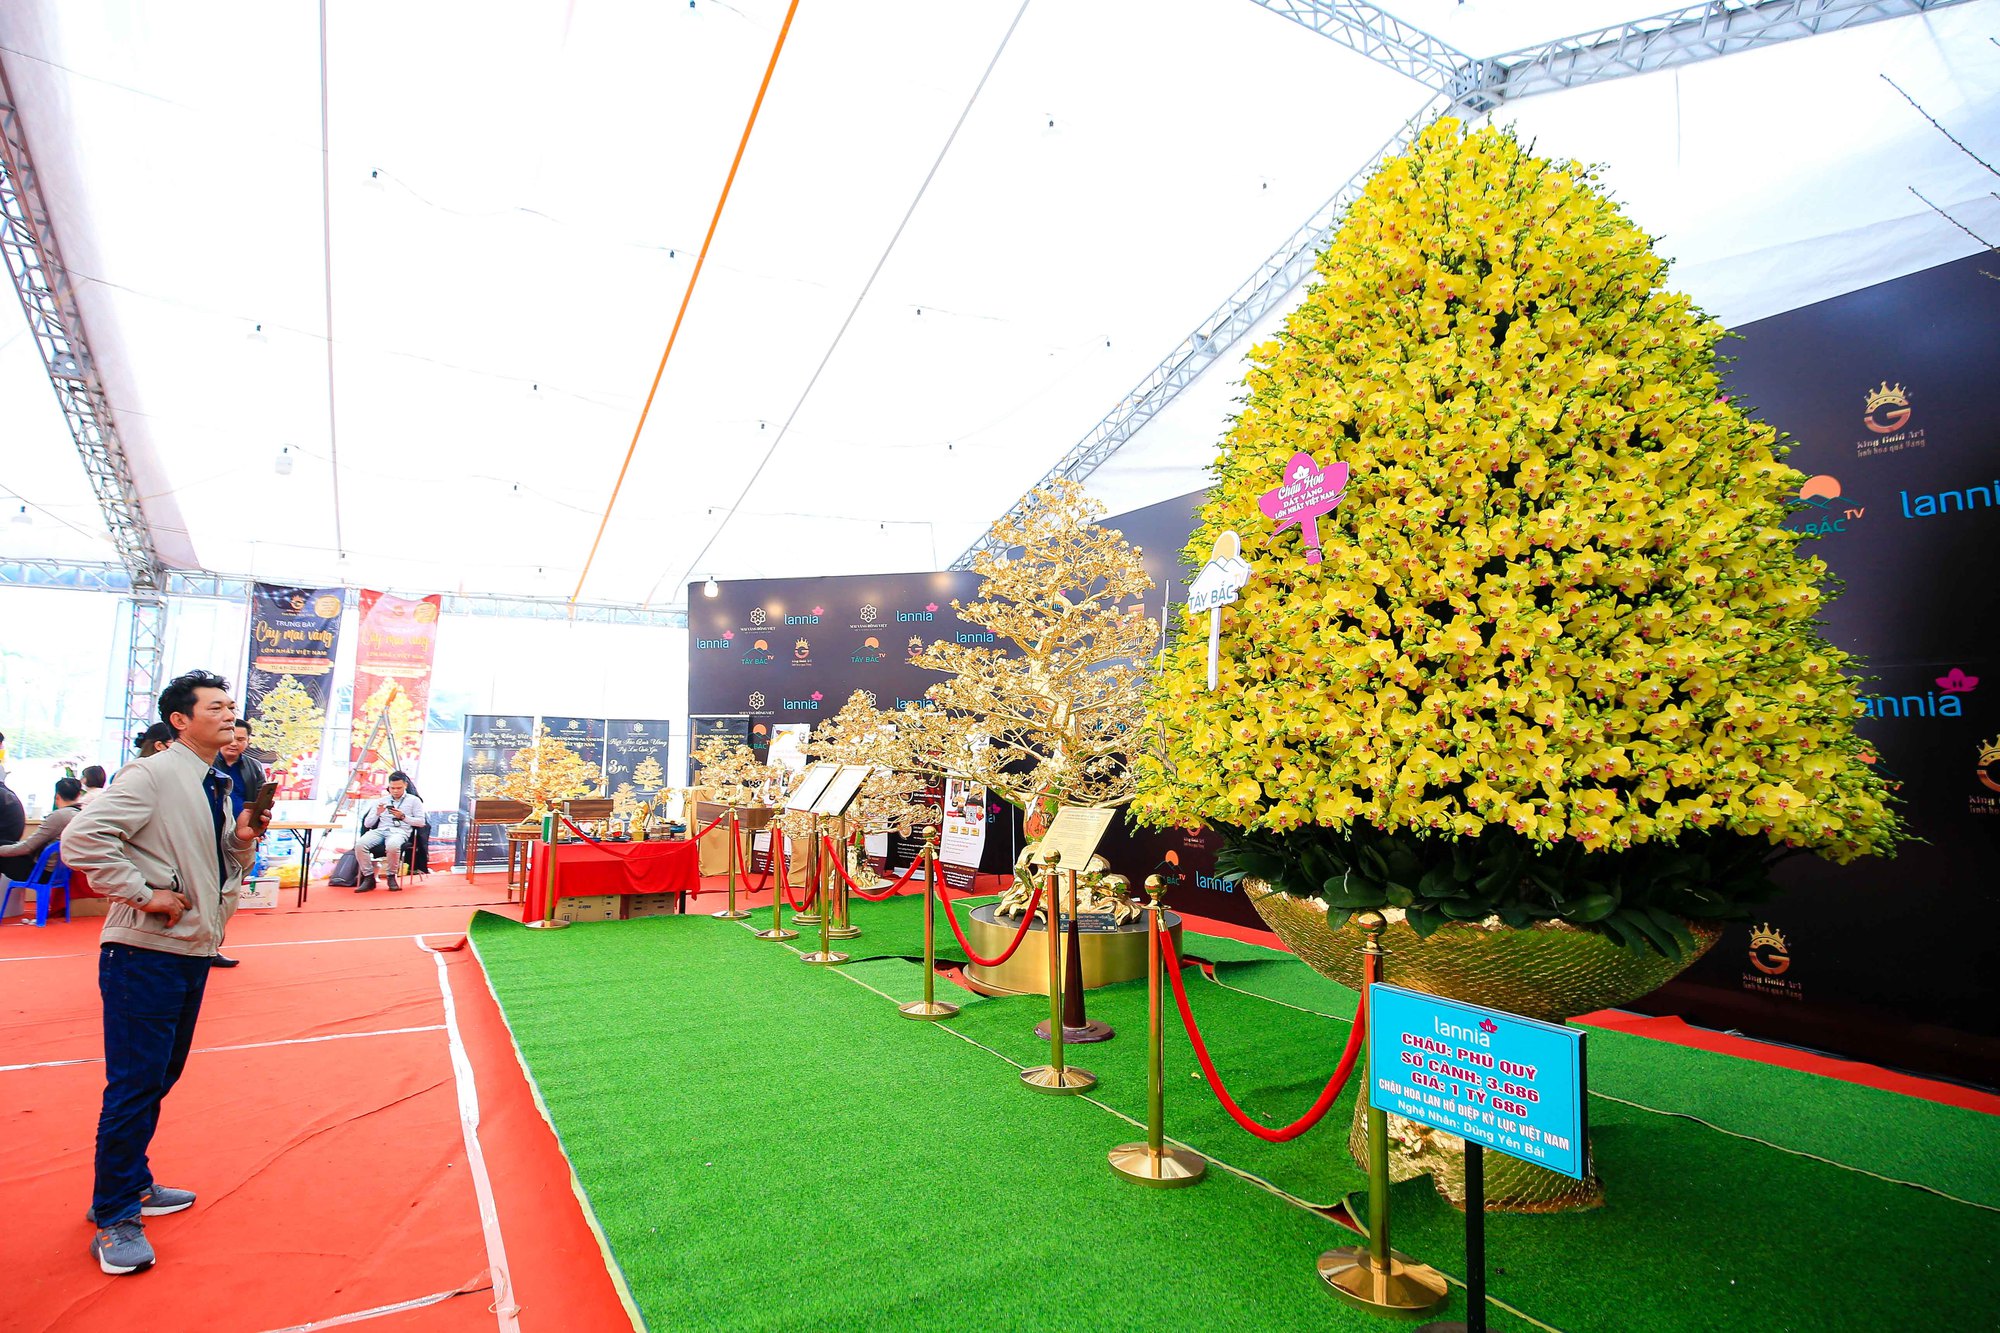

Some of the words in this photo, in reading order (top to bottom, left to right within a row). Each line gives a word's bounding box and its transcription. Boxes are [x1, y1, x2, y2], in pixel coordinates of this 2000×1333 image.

[1303, 472, 1325, 491] Hoa
[1320, 489, 1336, 502] NAM
[1844, 507, 1865, 520] TV
[1188, 591, 1208, 611] TÂY
[1210, 580, 1235, 605] BẮC
[275, 620, 301, 628] TRUNG
[784, 613, 820, 626] lannia
[896, 610, 934, 623] lannia
[256, 620, 281, 647] Cây
[283, 628, 305, 642] mai
[696, 637, 730, 650] lannia
[956, 631, 995, 644] lannia
[783, 697, 819, 711] lannia
[1855, 691, 1962, 717] annia
[1178, 873, 1186, 881] TV
[1195, 870, 1233, 894] lannia
[1434, 1015, 1491, 1048] lannia
[1401, 1032, 1453, 1058] CHẬU:
[1401, 1050, 1425, 1069] SỐ
[1427, 1060, 1482, 1087] CÀNH:
[1486, 1076, 1540, 1104] 3.686
[1411, 1071, 1446, 1093] GIÁ:
[1450, 1083, 1459, 1097] 1
[1491, 1096, 1528, 1118] 686
[1378, 1078, 1402, 1095] CHẬU
[1403, 1086, 1422, 1102] HOA
[1422, 1092, 1441, 1108] LAN
[1457, 1103, 1480, 1121] ĐIỆP
[1496, 1116, 1517, 1134] LỤC
[1519, 1122, 1542, 1142] VIỆT
[1543, 1130, 1570, 1152] NAM
[1398, 1099, 1426, 1119] Nghệ
[1427, 1110, 1461, 1129] Nhân:
[1497, 1132, 1522, 1150] Yên
[1524, 1142, 1546, 1159] Bái
